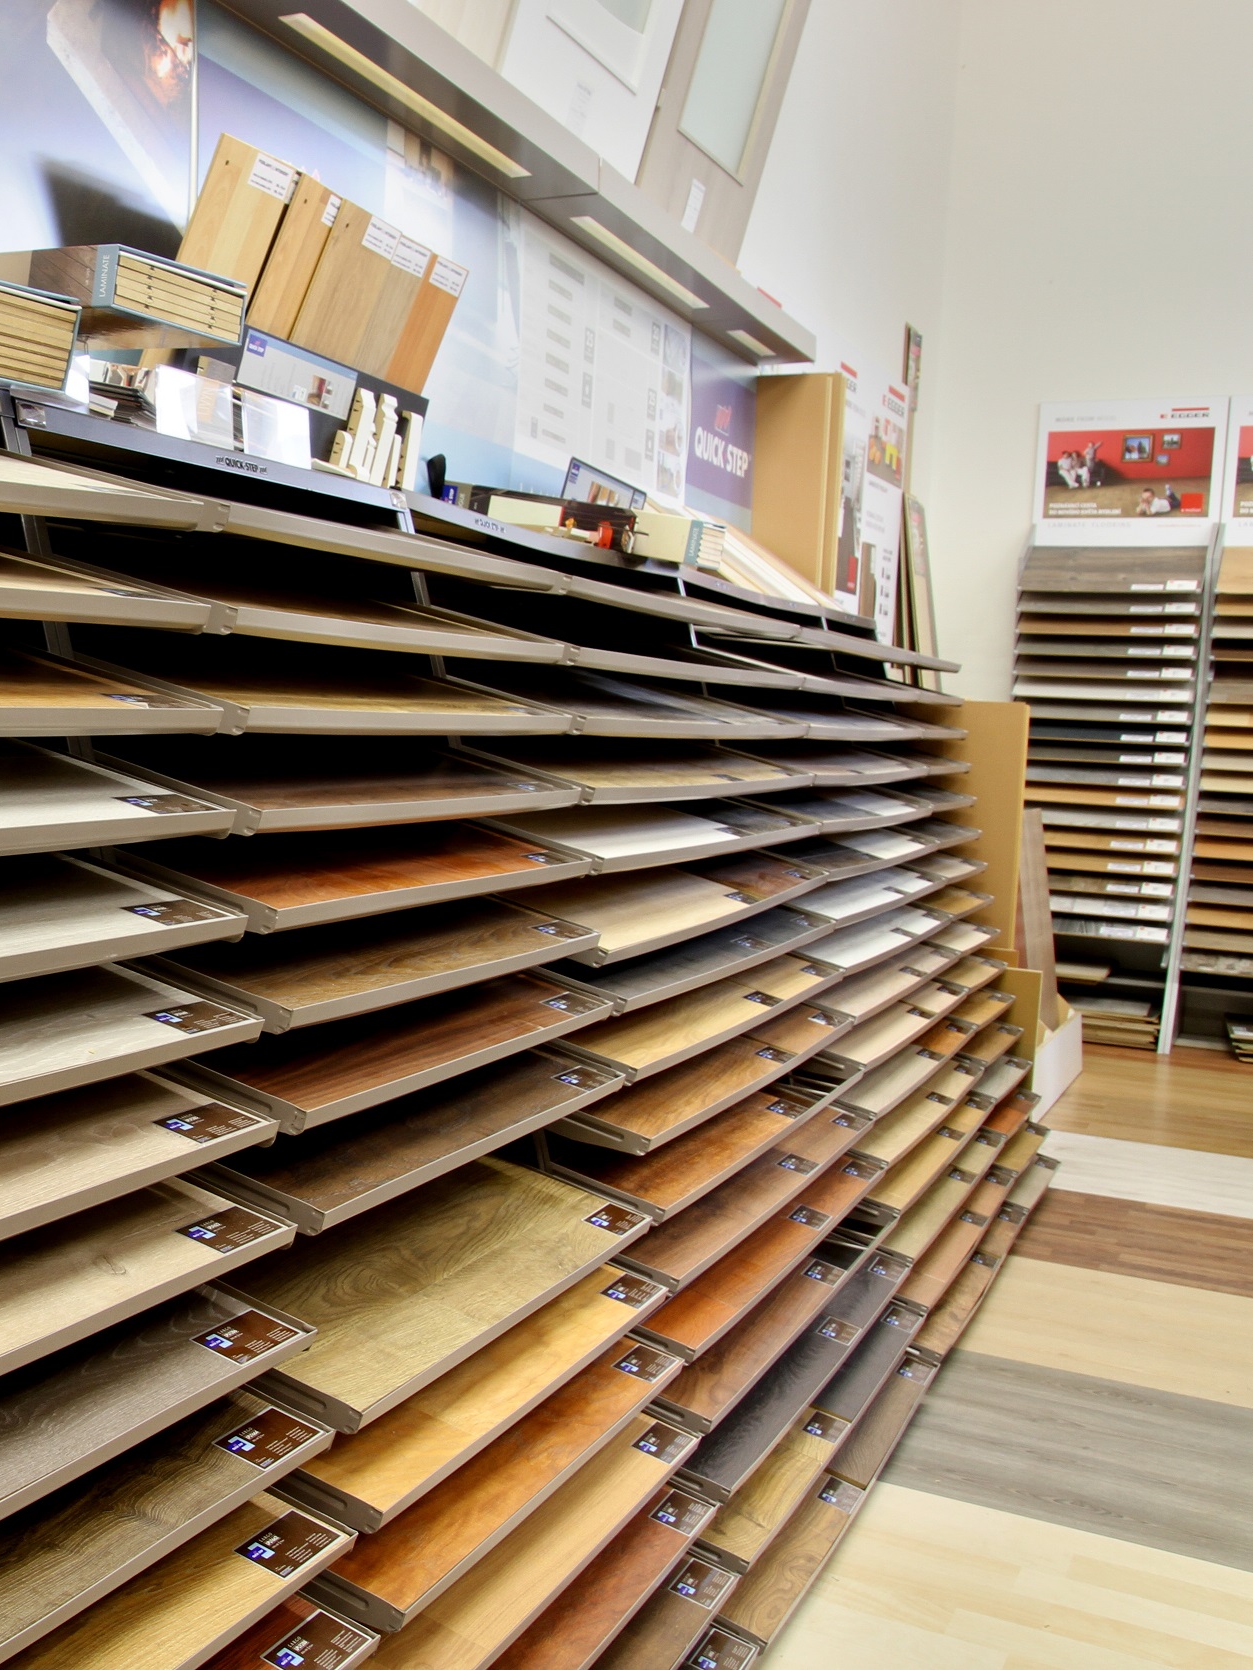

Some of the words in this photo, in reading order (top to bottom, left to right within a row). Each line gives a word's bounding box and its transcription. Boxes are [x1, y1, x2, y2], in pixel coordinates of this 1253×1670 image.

[98, 254, 110, 298] LAMINATE
[694, 426, 725, 469] QUICK
[725, 443, 749, 478] STEP
